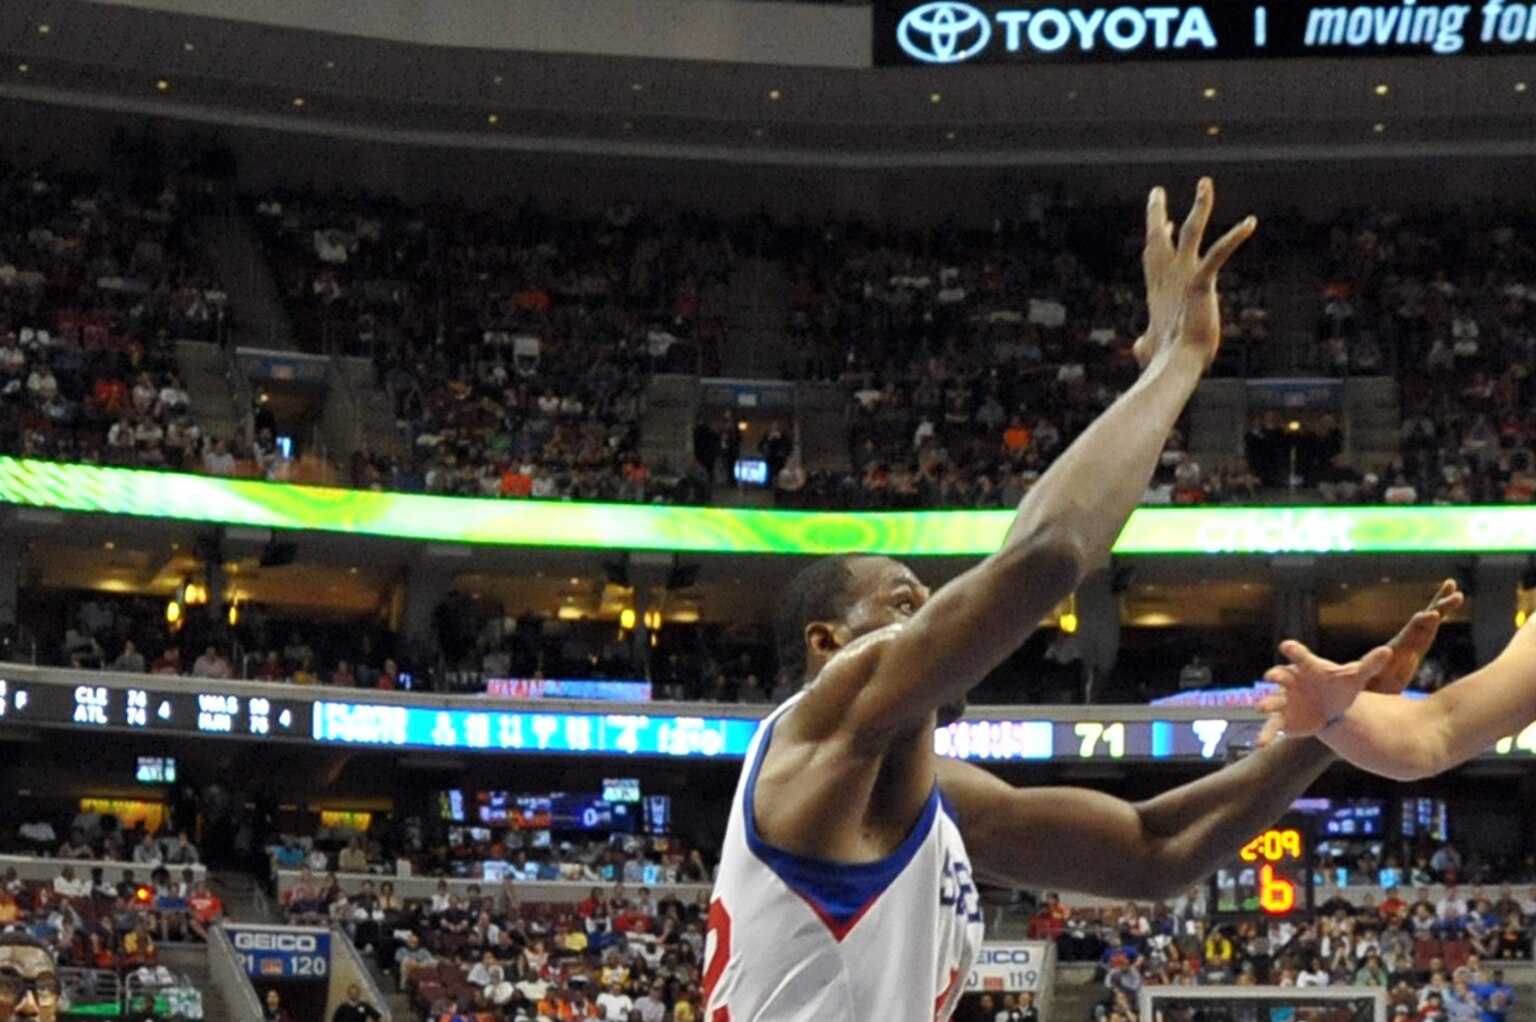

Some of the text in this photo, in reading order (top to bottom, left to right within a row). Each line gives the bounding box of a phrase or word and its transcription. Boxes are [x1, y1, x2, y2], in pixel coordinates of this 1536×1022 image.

[996, 7, 1217, 51] TOYOTA
[1304, 0, 1470, 53] moving
[74, 686, 109, 705] CLE
[74, 704, 108, 725] ATL
[1074, 722, 1126, 758] 71
[234, 932, 317, 952] GEICO
[290, 956, 327, 975] 120
[976, 950, 1031, 965] EICO
[1009, 971, 1038, 988] 119
